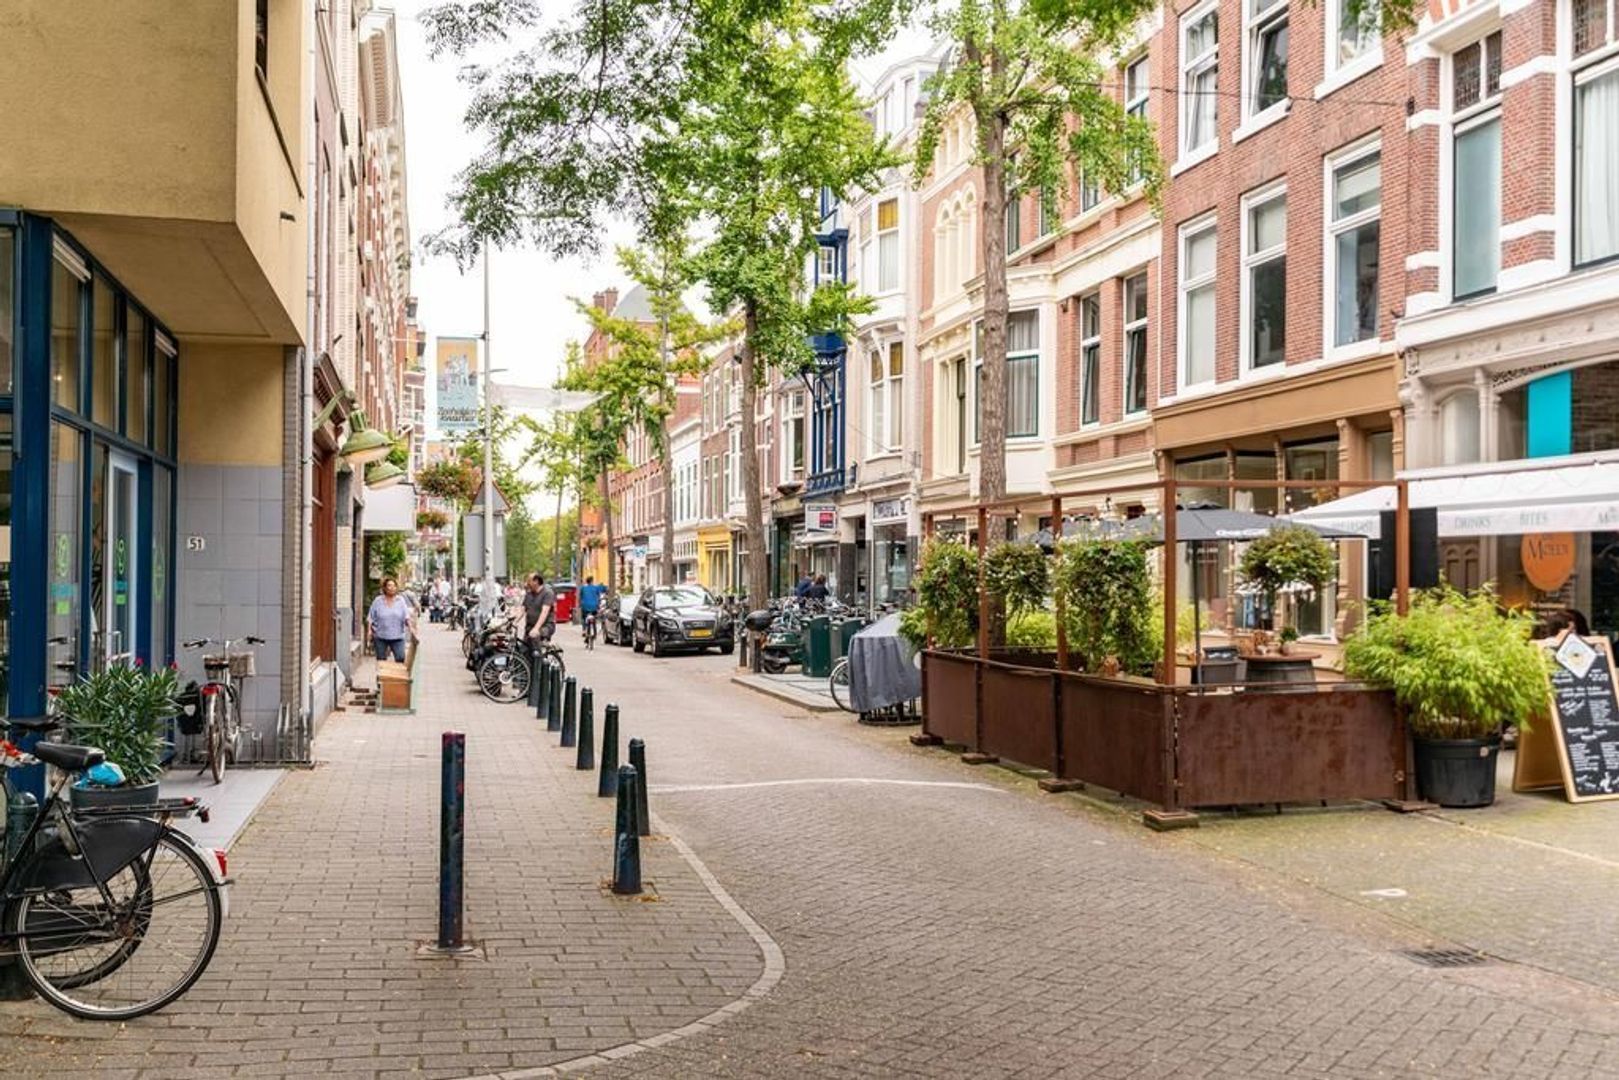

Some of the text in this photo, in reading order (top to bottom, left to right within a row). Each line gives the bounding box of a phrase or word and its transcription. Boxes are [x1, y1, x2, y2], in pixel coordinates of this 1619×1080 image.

[1454, 511, 1548, 529] DRINKS BITES
[190, 537, 202, 550] 51
